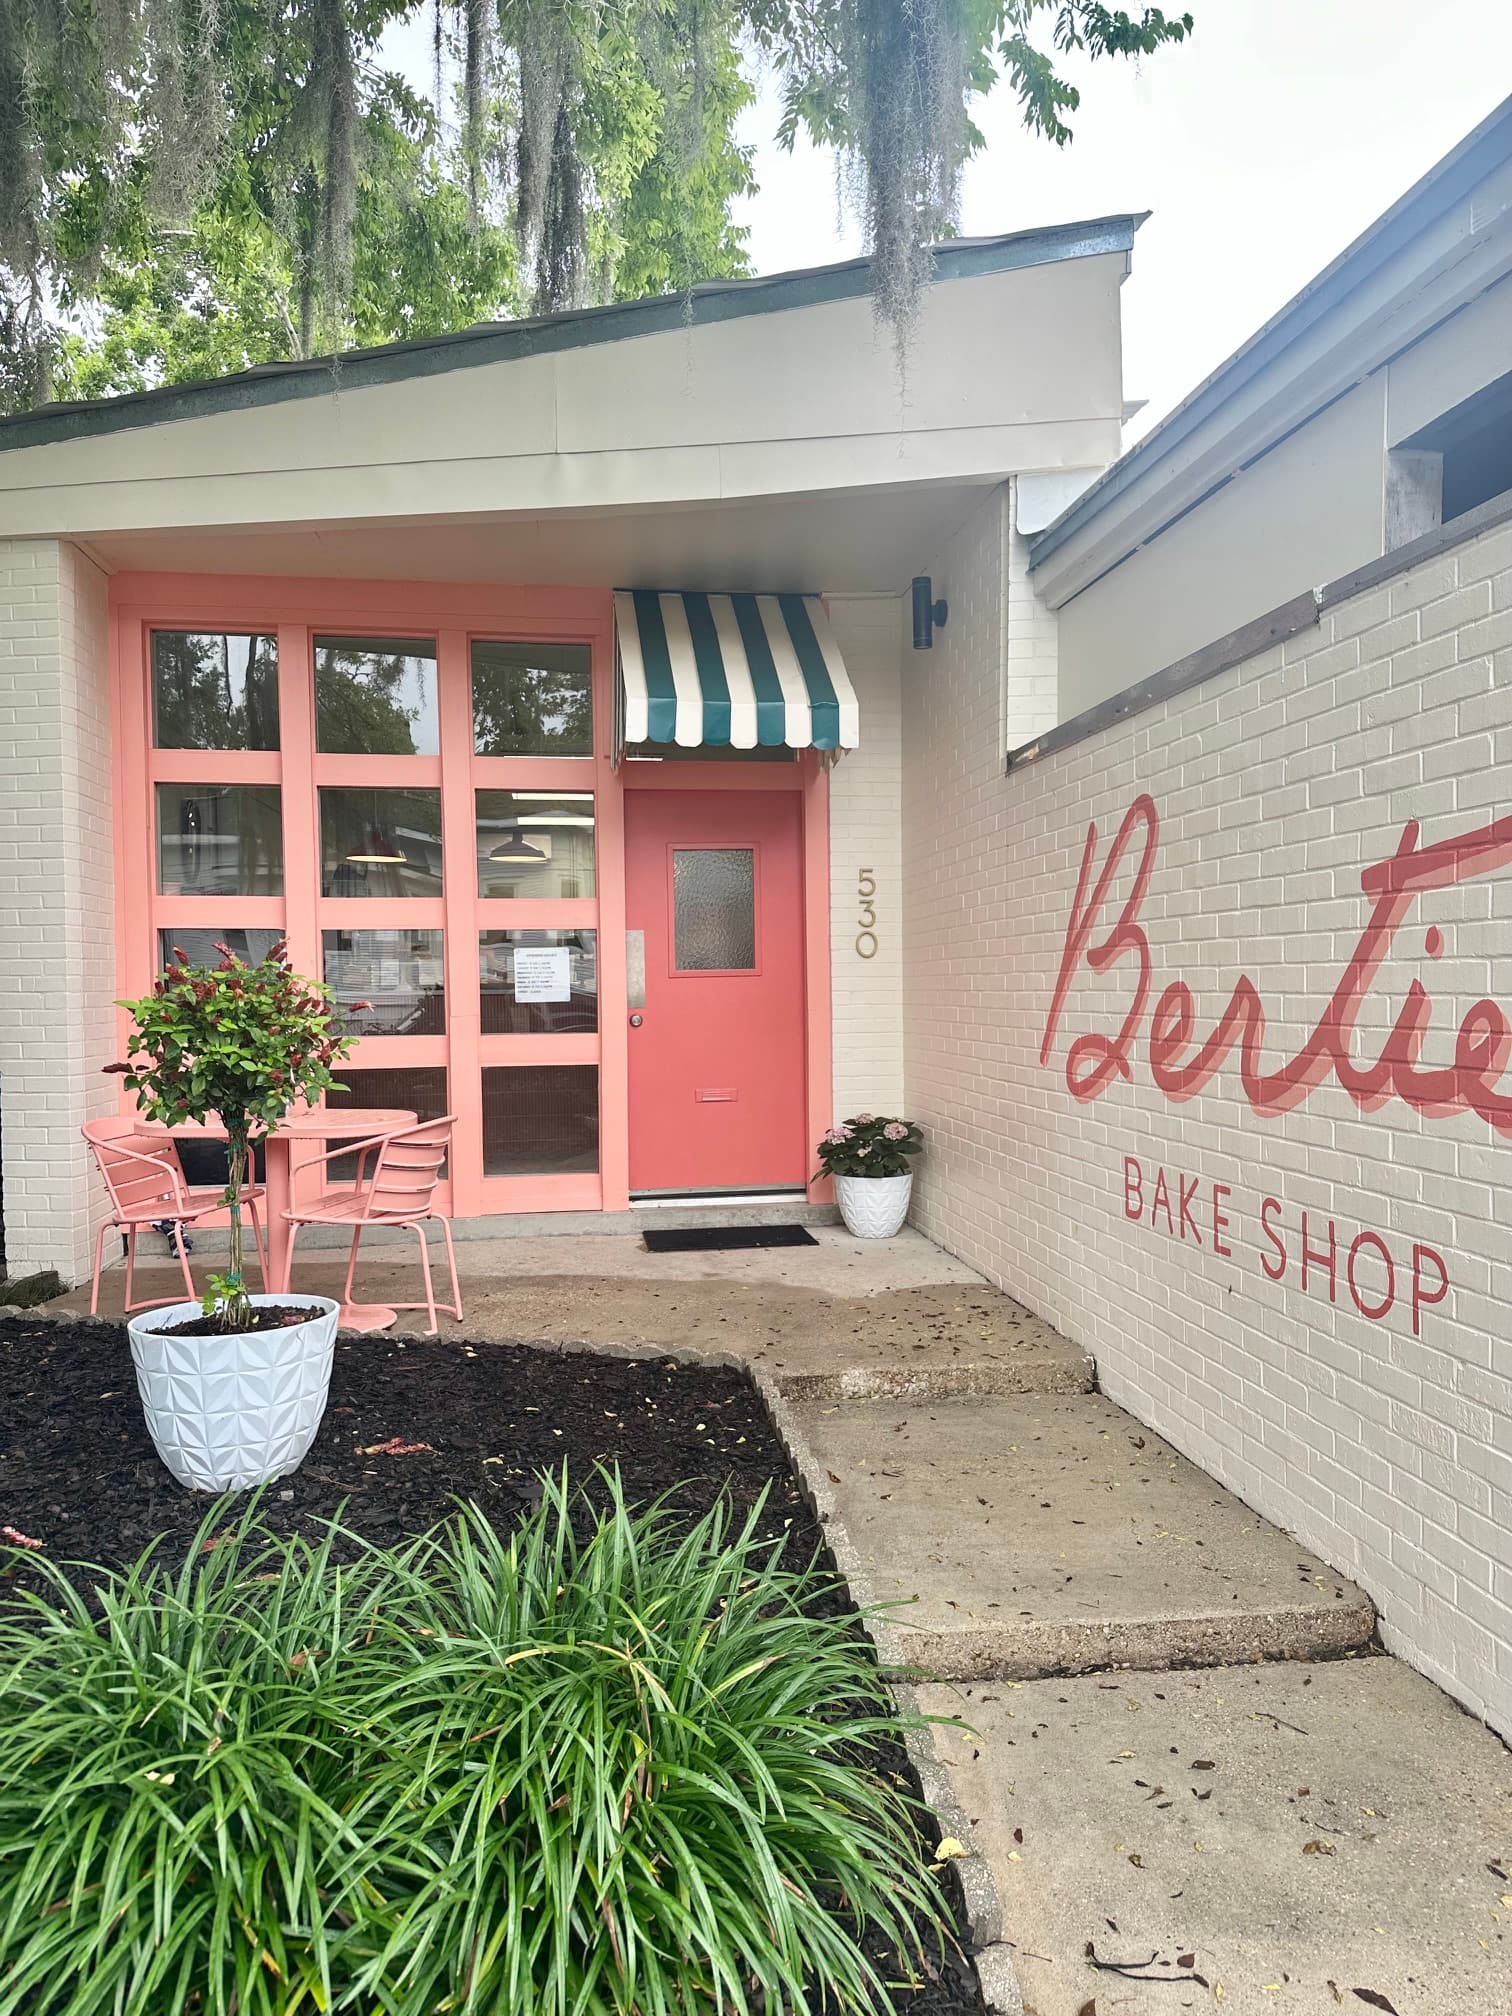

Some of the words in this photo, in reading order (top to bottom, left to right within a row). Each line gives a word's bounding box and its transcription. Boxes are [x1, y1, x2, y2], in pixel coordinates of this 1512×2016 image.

[857, 868, 879, 959] 530
[1125, 1156, 1232, 1258] BAKE
[1260, 1197, 1449, 1335] SHOP
